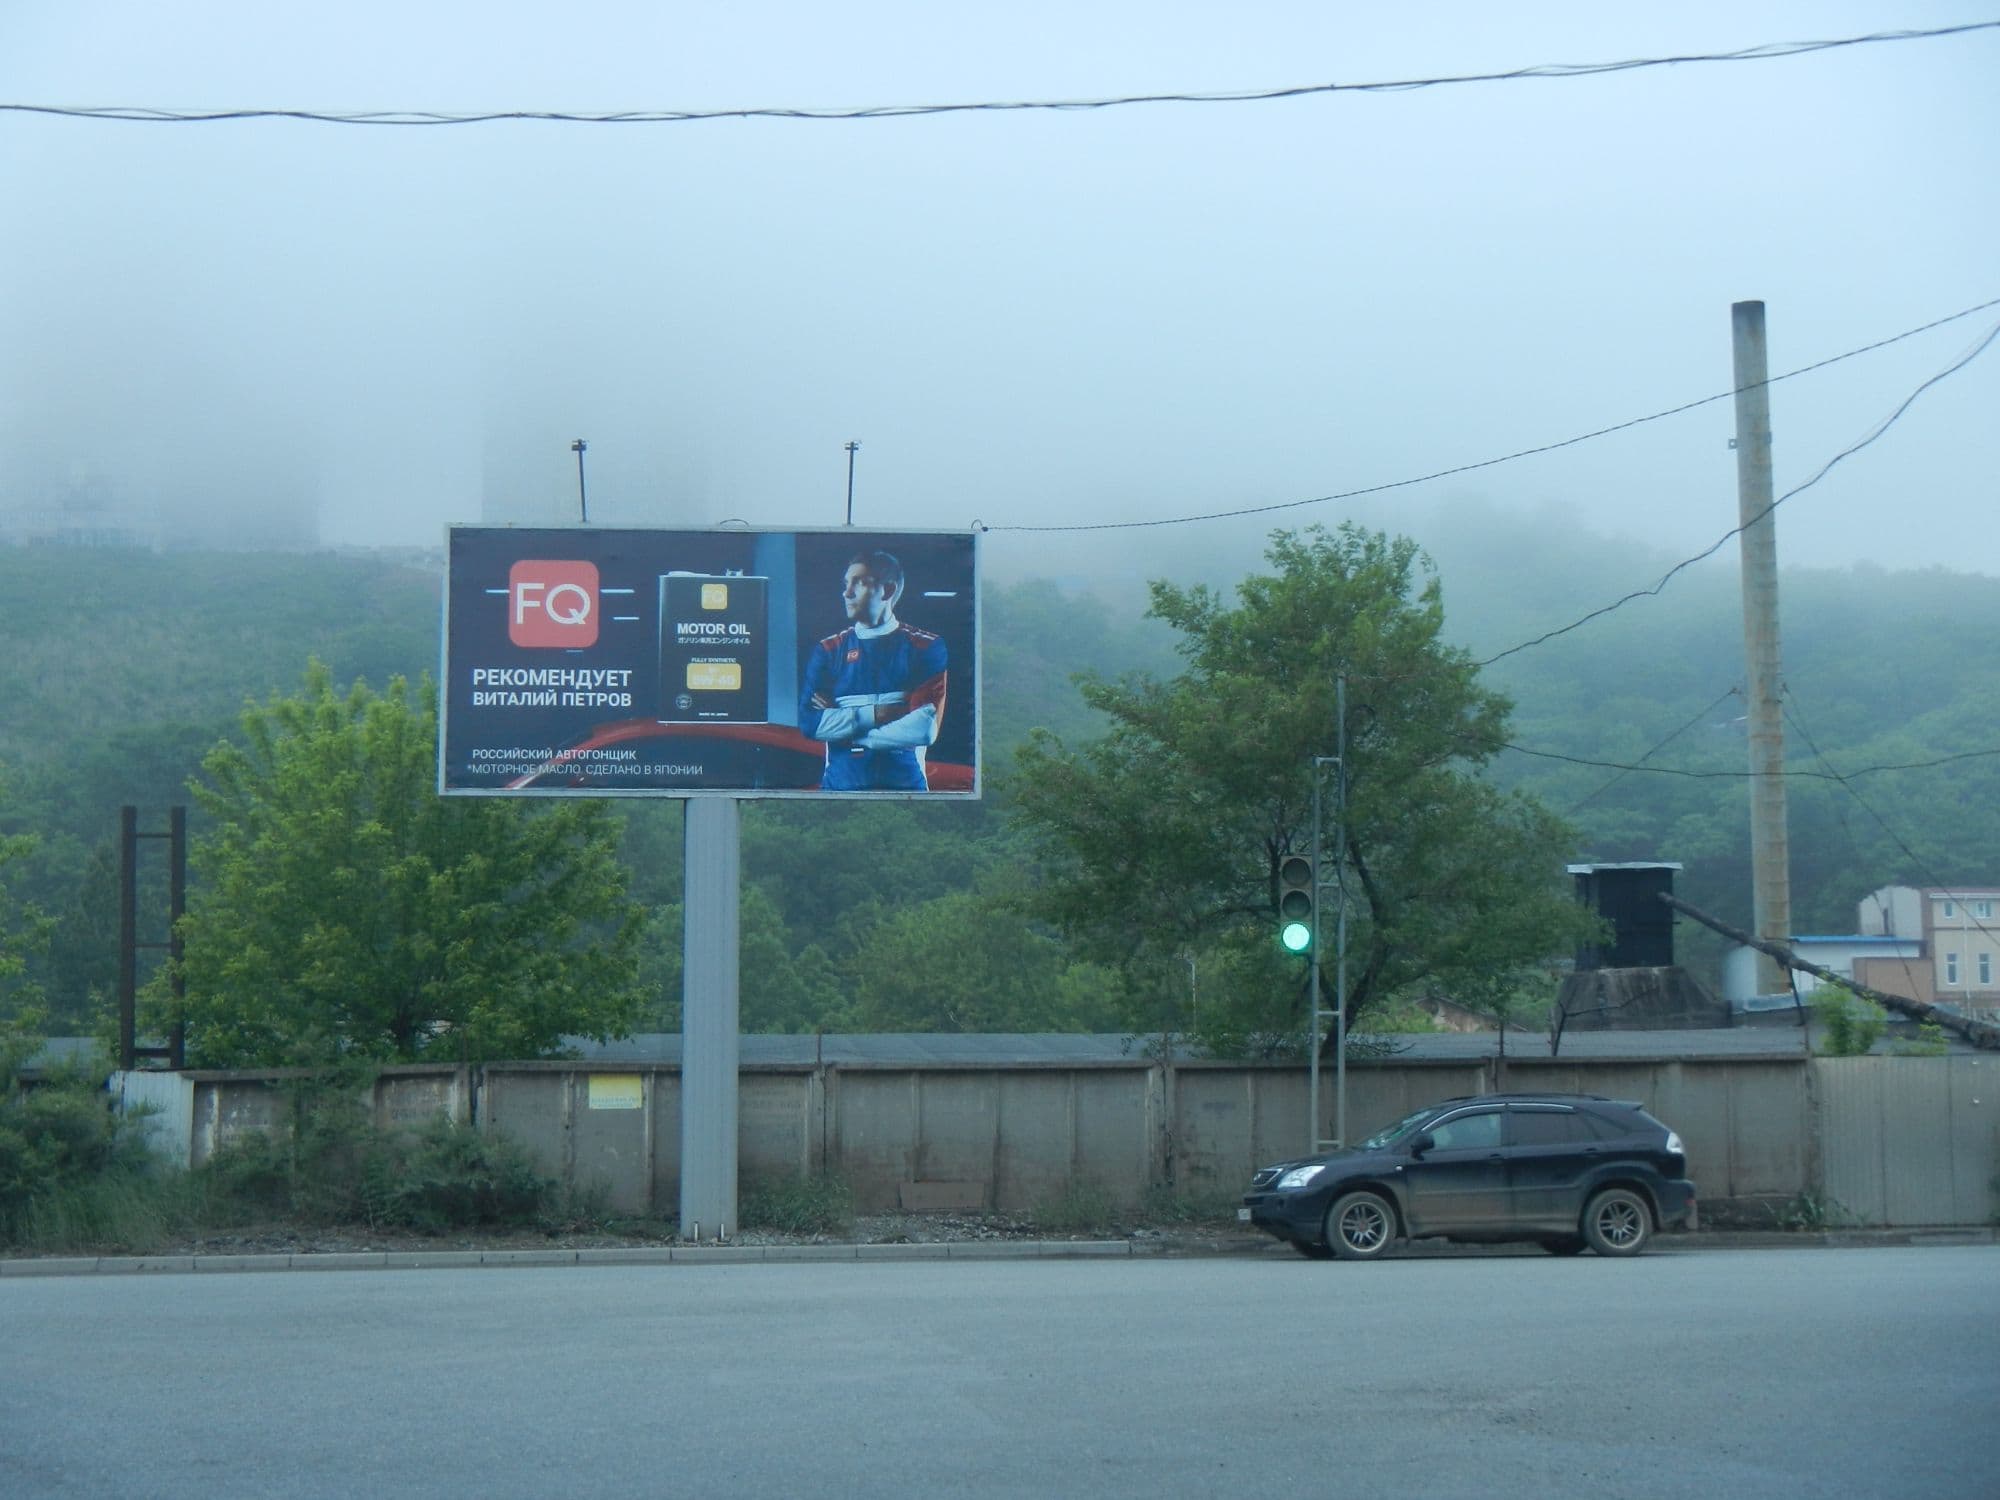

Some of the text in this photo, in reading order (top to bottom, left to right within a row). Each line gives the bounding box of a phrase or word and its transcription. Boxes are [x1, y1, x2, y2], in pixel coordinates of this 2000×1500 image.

[516, 583, 591, 624] FQ
[677, 623, 751, 635] MOTOR OIL
[473, 668, 633, 690] РЕКОМЕНДУЕТ
[473, 689, 632, 707] ВИТАЛИЙ ПЕТРОВ
[472, 747, 637, 762] РОССИЙСКИЙ АВТОГОНЩИК
[539, 764, 581, 776] МАСЛО
[585, 764, 641, 777] СДЕЛАНО
[644, 765, 651, 775] В
[654, 765, 703, 776] ЯПОНИИ
